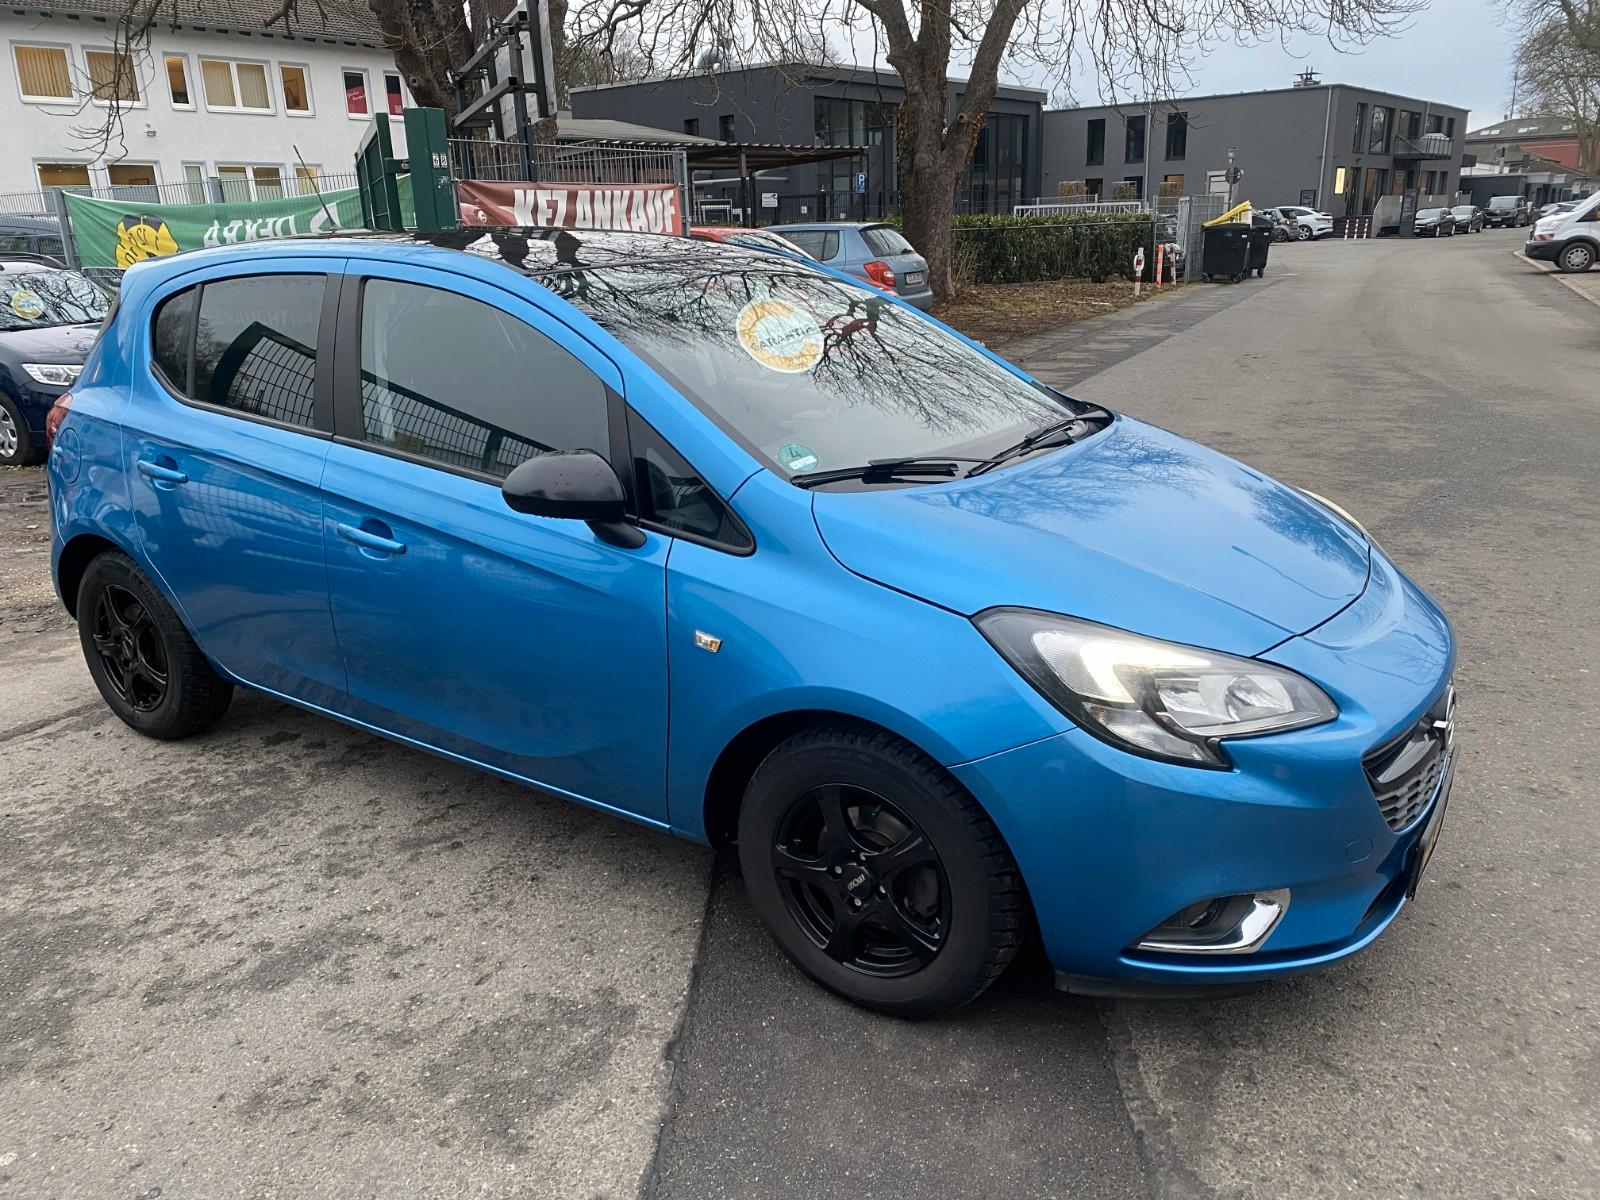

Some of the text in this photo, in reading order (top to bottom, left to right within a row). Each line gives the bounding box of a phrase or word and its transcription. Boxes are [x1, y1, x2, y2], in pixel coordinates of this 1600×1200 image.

[858, 174, 866, 185] P
[513, 189, 676, 233] KFZ ANKAUF
